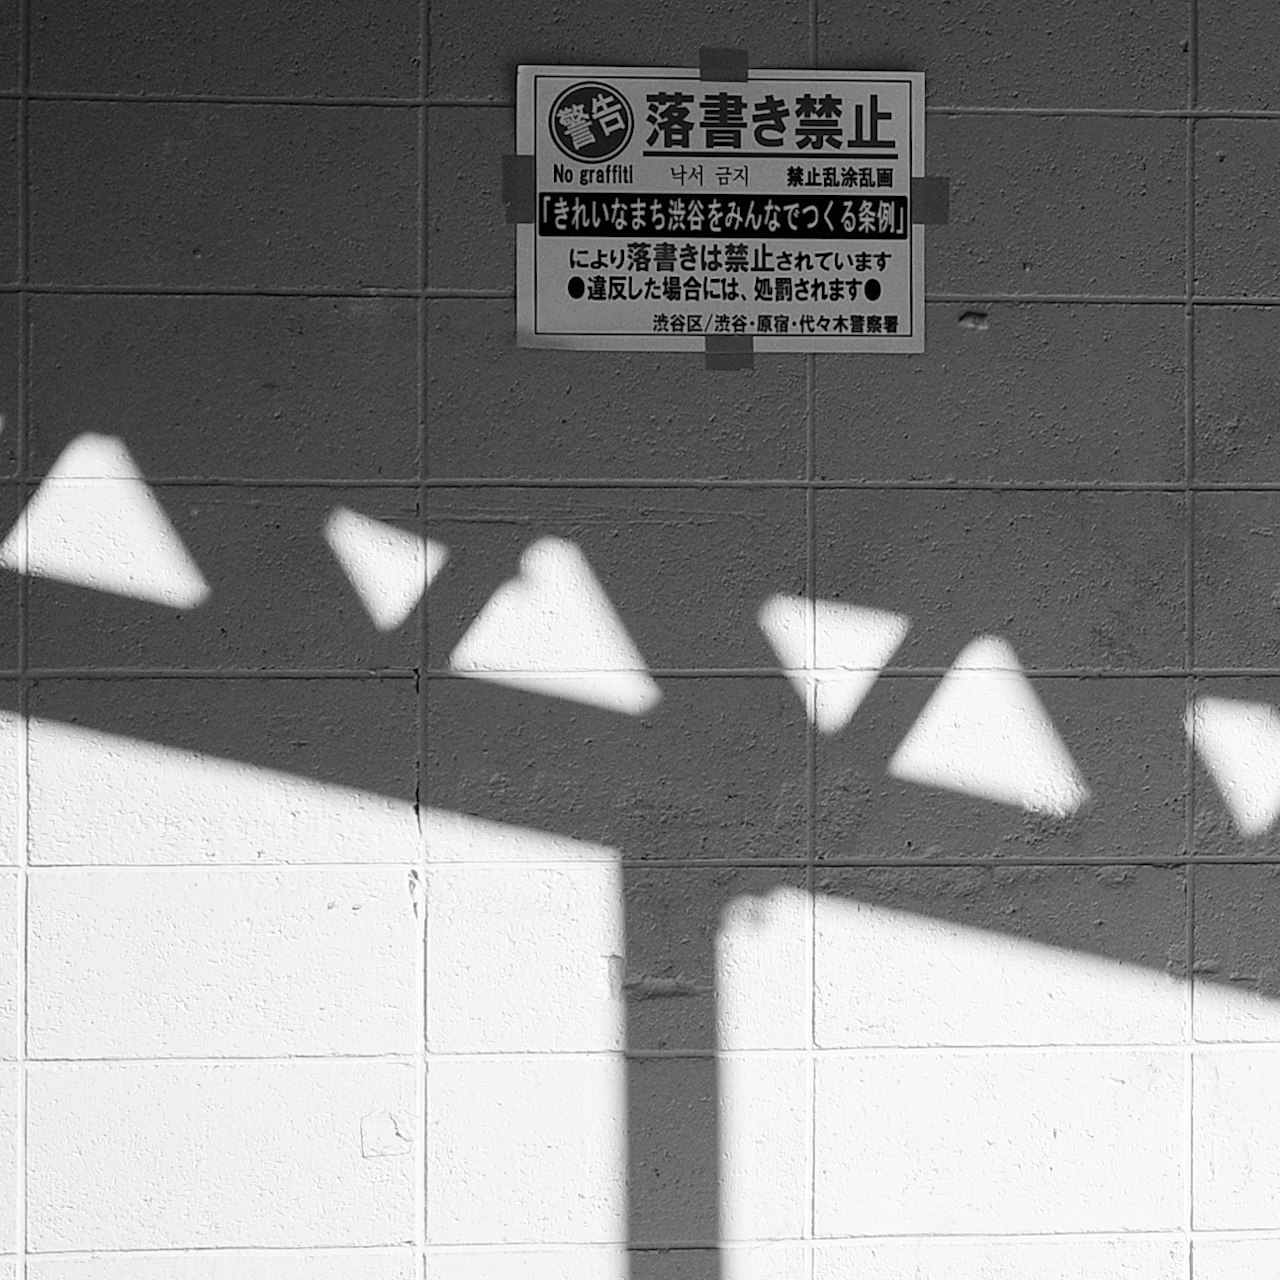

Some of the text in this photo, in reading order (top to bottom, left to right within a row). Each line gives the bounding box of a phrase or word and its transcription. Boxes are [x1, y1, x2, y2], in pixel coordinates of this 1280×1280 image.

[556, 91, 626, 152] 警告
[645, 92, 896, 150] 落書き禁止
[553, 164, 633, 185] No graffiti
[670, 165, 749, 187] 낙서 금지
[542, 196, 904, 235] 「きれいなまち渋谷をみんなでつくる条例」
[569, 242, 892, 274] により落書きは禁止されています
